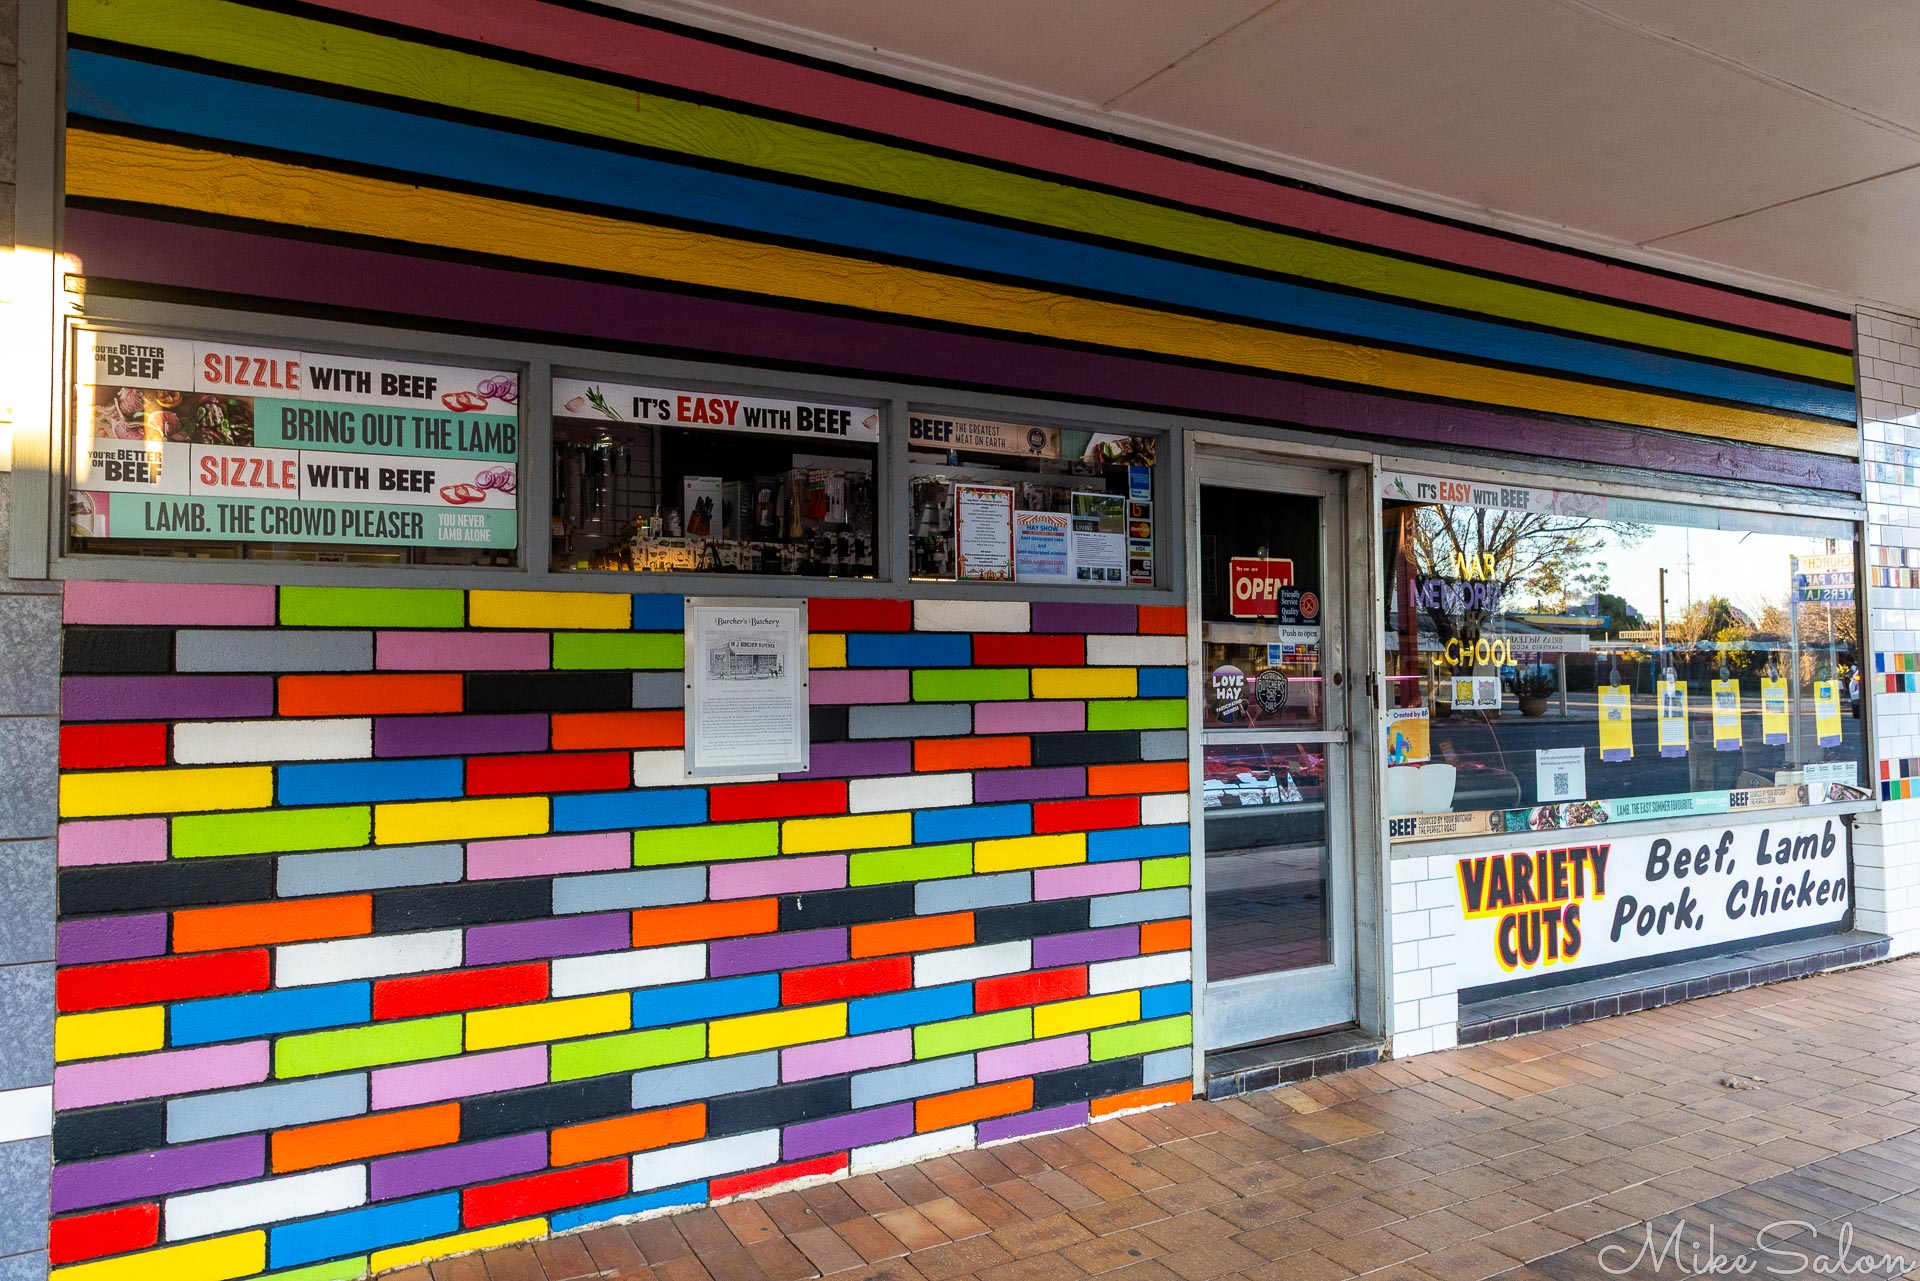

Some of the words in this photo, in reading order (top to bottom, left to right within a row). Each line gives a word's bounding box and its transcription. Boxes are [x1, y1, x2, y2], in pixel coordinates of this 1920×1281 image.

[91, 344, 118, 354] OU'RE
[119, 344, 164, 358] BETTER
[94, 353, 106, 362] ON
[107, 354, 164, 380] BEEF
[203, 352, 300, 392] SIZZLE
[309, 366, 372, 395] WITH
[380, 372, 438, 400] BEEF
[632, 396, 670, 421] IT'S
[677, 395, 739, 426] EASY
[743, 406, 791, 430] WITH
[796, 405, 852, 436] BEEF
[280, 407, 355, 446] BRING
[361, 412, 408, 449] OUT
[412, 414, 452, 451] THE
[458, 418, 516, 454] LAMB
[909, 417, 953, 443] BEEF
[955, 422, 968, 434] THE
[968, 424, 1000, 436] GREATEST
[955, 433, 973, 445] MEAT
[974, 436, 983, 446] ON
[984, 437, 1006, 448] EARTH
[88, 450, 117, 461] YOU'RE
[117, 449, 163, 463] BETTER
[91, 459, 104, 468] ON
[104, 460, 163, 484] BEEF
[200, 455, 296, 490] SIZZLE
[306, 464, 370, 490] WITH
[378, 468, 436, 494] BEEF
[1417, 482, 1437, 500] IT'S
[1439, 481, 1471, 504] EASY
[1473, 490, 1498, 506] WITH
[1500, 488, 1530, 510] BEEF
[144, 501, 212, 533] LAMB.
[218, 504, 256, 535] THE
[260, 506, 336, 538] CROWD
[341, 510, 424, 540] PLEASER
[438, 512, 456, 528] YOU
[457, 514, 485, 529] NEVER
[438, 526, 462, 541] LAMB
[464, 528, 491, 542] ALONE
[1448, 550, 1496, 582] WAR
[1236, 576, 1288, 600] OPEN
[1281, 590, 1300, 600] Friendly
[1410, 578, 1502, 610] MEMORIA
[1281, 598, 1298, 606] Service
[1281, 607, 1300, 617] Quality
[714, 617, 748, 627] Burcher's
[748, 617, 780, 628] Butchery
[1304, 631, 1317, 639] open
[1212, 675, 1244, 688] LOVE
[1216, 687, 1242, 700] HAY
[1616, 803, 1630, 816] LAMB.
[1631, 802, 1640, 815] THE
[1640, 802, 1652, 815] EASY
[1652, 800, 1670, 814] SUMMER
[1729, 792, 1749, 807] BEEF
[1389, 818, 1417, 837] BEEF
[1418, 816, 1437, 826] SOURCED
[1437, 815, 1443, 824] BY
[1444, 814, 1454, 824] YOUR
[1454, 814, 1472, 823] BUTCHER
[1418, 826, 1426, 835] THE
[1426, 825, 1444, 834] PERFECT
[1444, 824, 1456, 832] ROAST
[1645, 830, 1736, 882] Beef,
[1756, 820, 1835, 866] Lamb
[1456, 843, 1611, 920] VARIETY
[1610, 887, 1703, 942] Pork,
[1725, 870, 1845, 920] Chicken
[1494, 903, 1582, 972] CUTS
